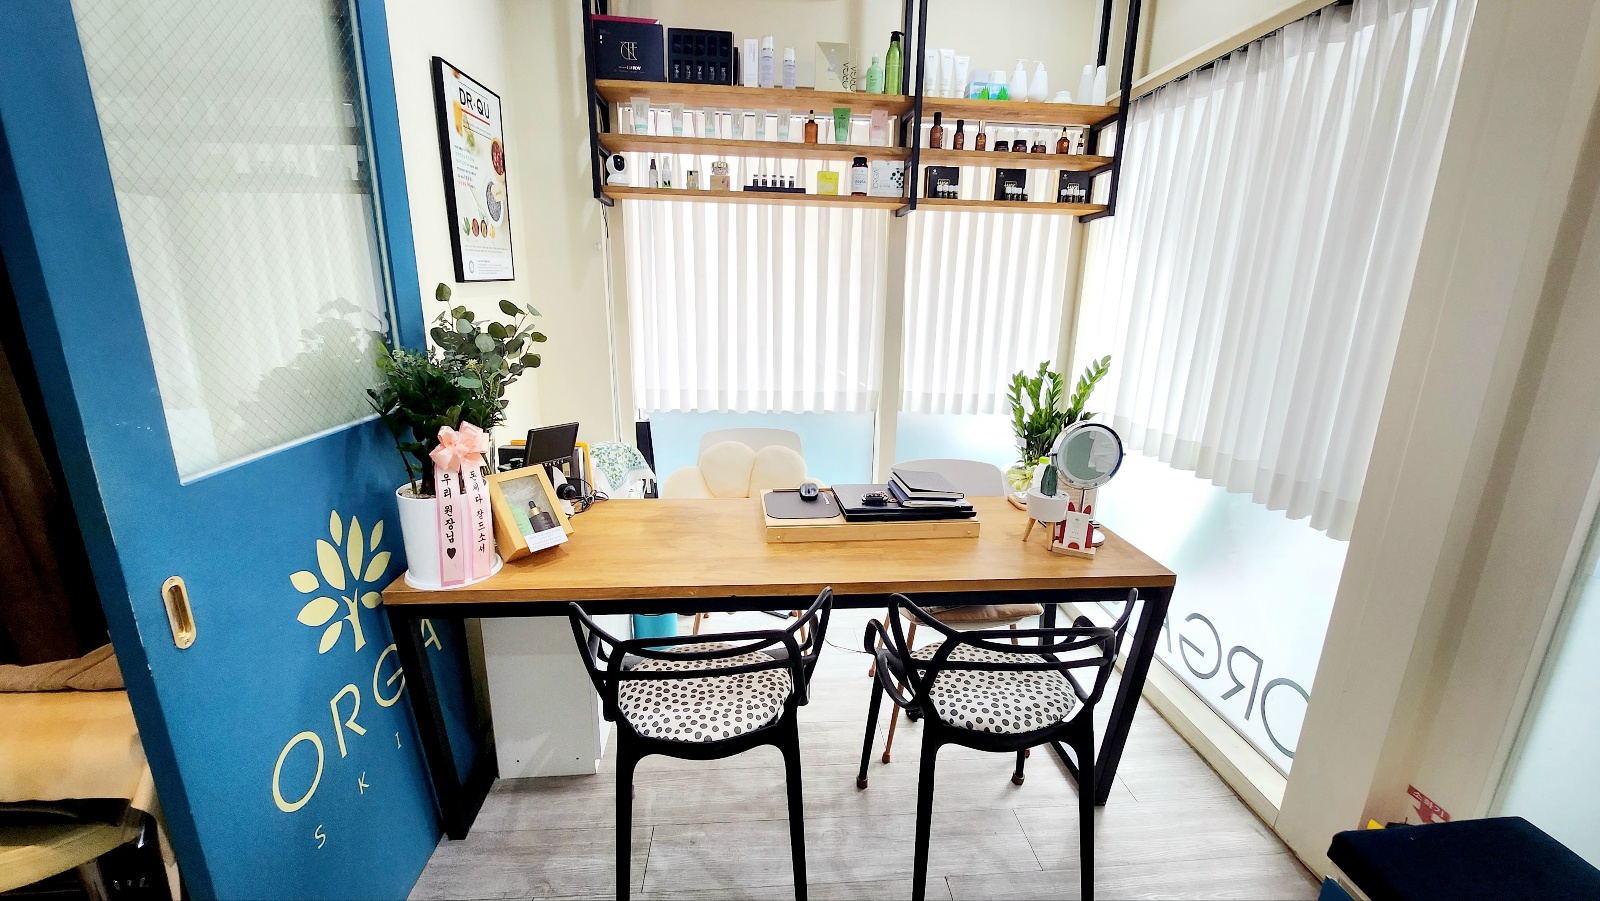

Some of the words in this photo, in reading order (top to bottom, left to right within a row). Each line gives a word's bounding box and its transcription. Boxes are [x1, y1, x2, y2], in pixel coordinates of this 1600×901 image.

[441, 474, 452, 499] 우리
[444, 505, 456, 543] 원장님
[1412, 791, 1445, 818] 소화기
